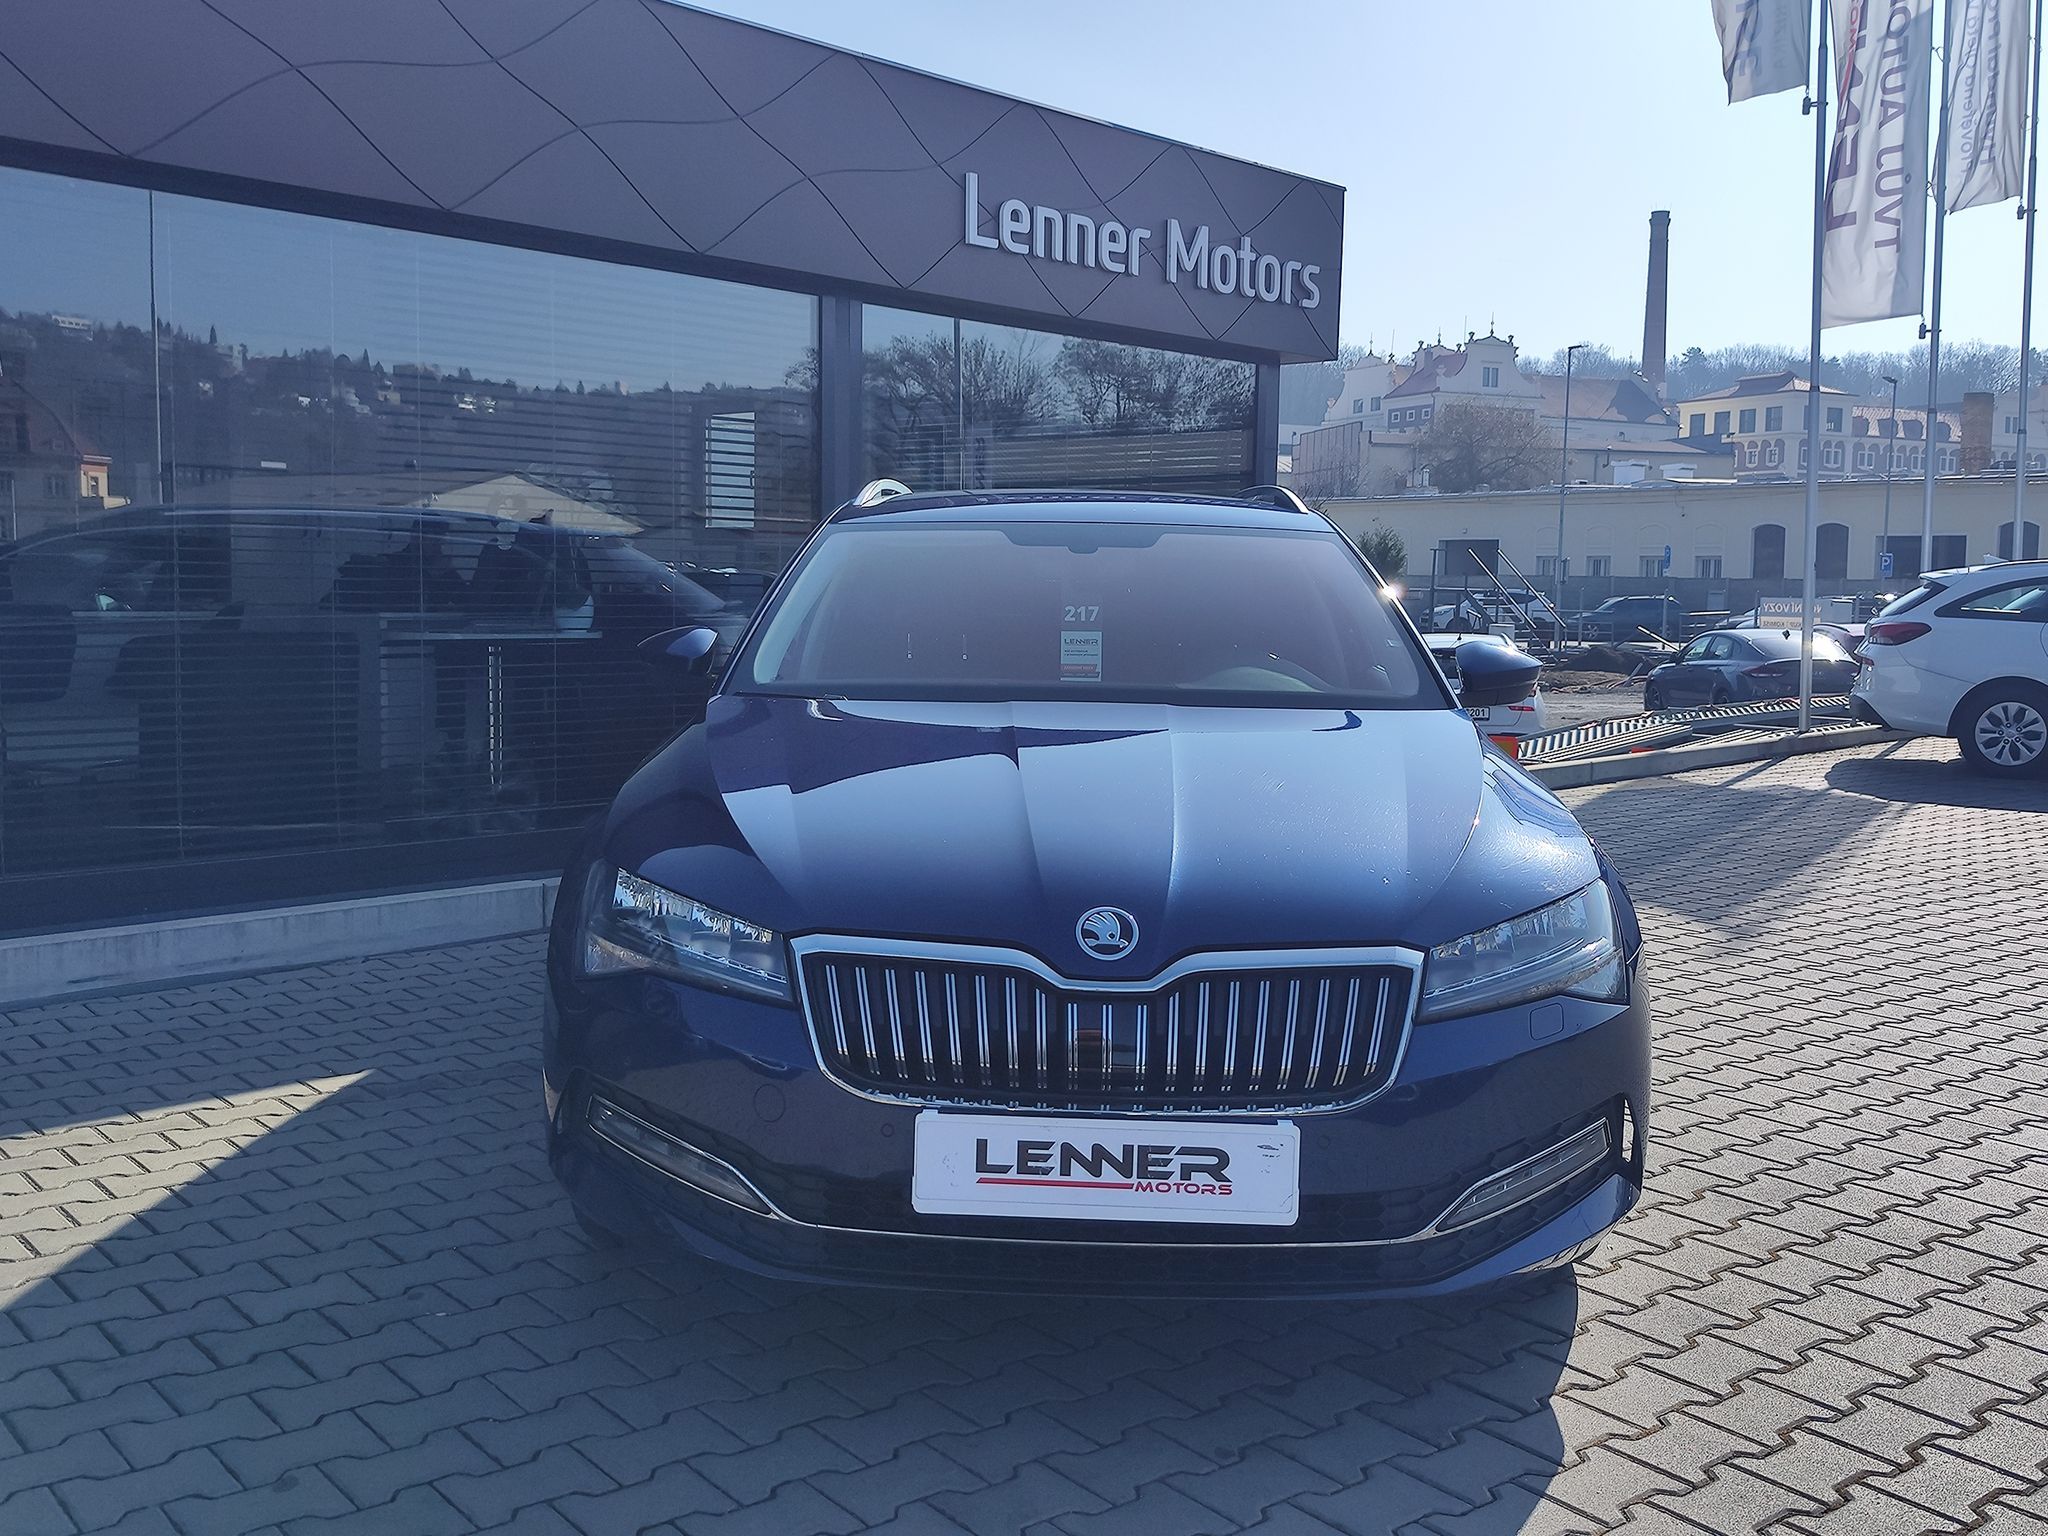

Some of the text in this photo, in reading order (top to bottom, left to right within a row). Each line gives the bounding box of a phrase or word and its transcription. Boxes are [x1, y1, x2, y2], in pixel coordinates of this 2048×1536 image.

[964, 171, 1321, 309] Lenner Motors
[1064, 605, 1100, 622] 217
[1467, 708, 1486, 717] 201
[975, 1137, 1233, 1183] LENNER
[1134, 1181, 1234, 1196] MOTORS
